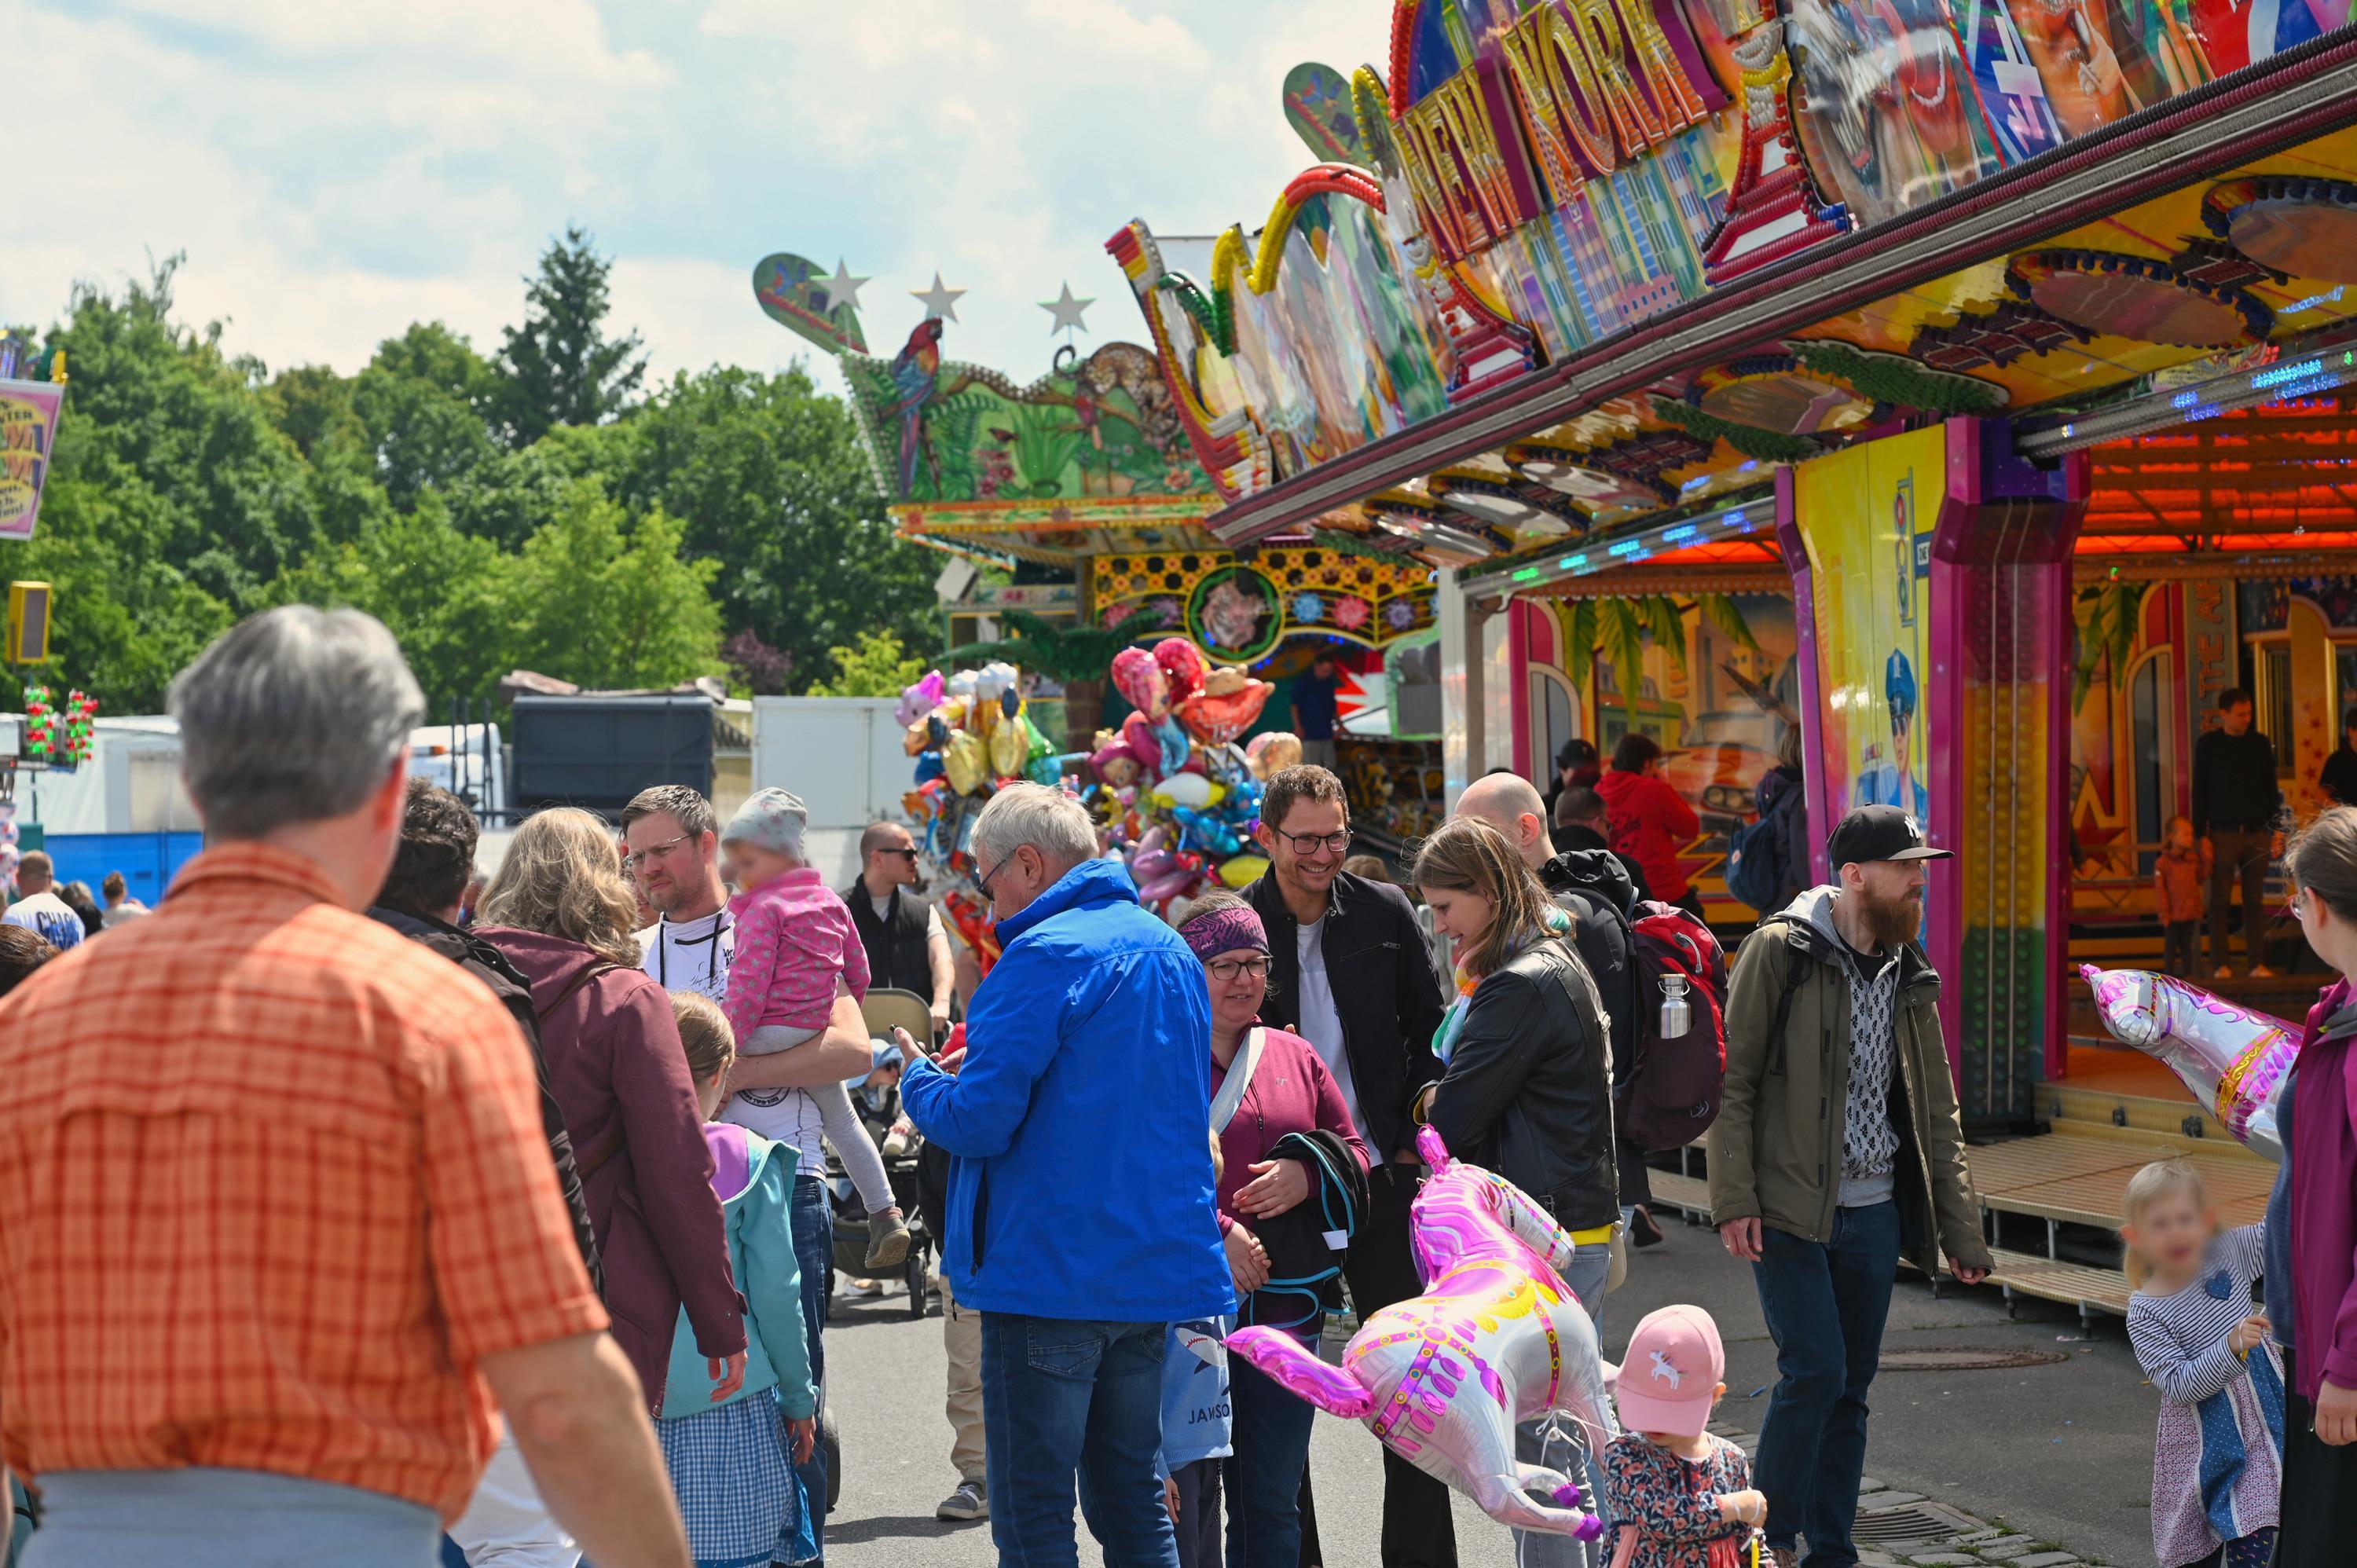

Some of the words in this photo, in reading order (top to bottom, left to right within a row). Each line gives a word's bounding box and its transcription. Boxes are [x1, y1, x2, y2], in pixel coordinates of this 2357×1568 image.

[1389, 63, 1523, 267] NEW
[1501, 0, 1708, 189] YORK
[2197, 632, 2227, 698] THE
